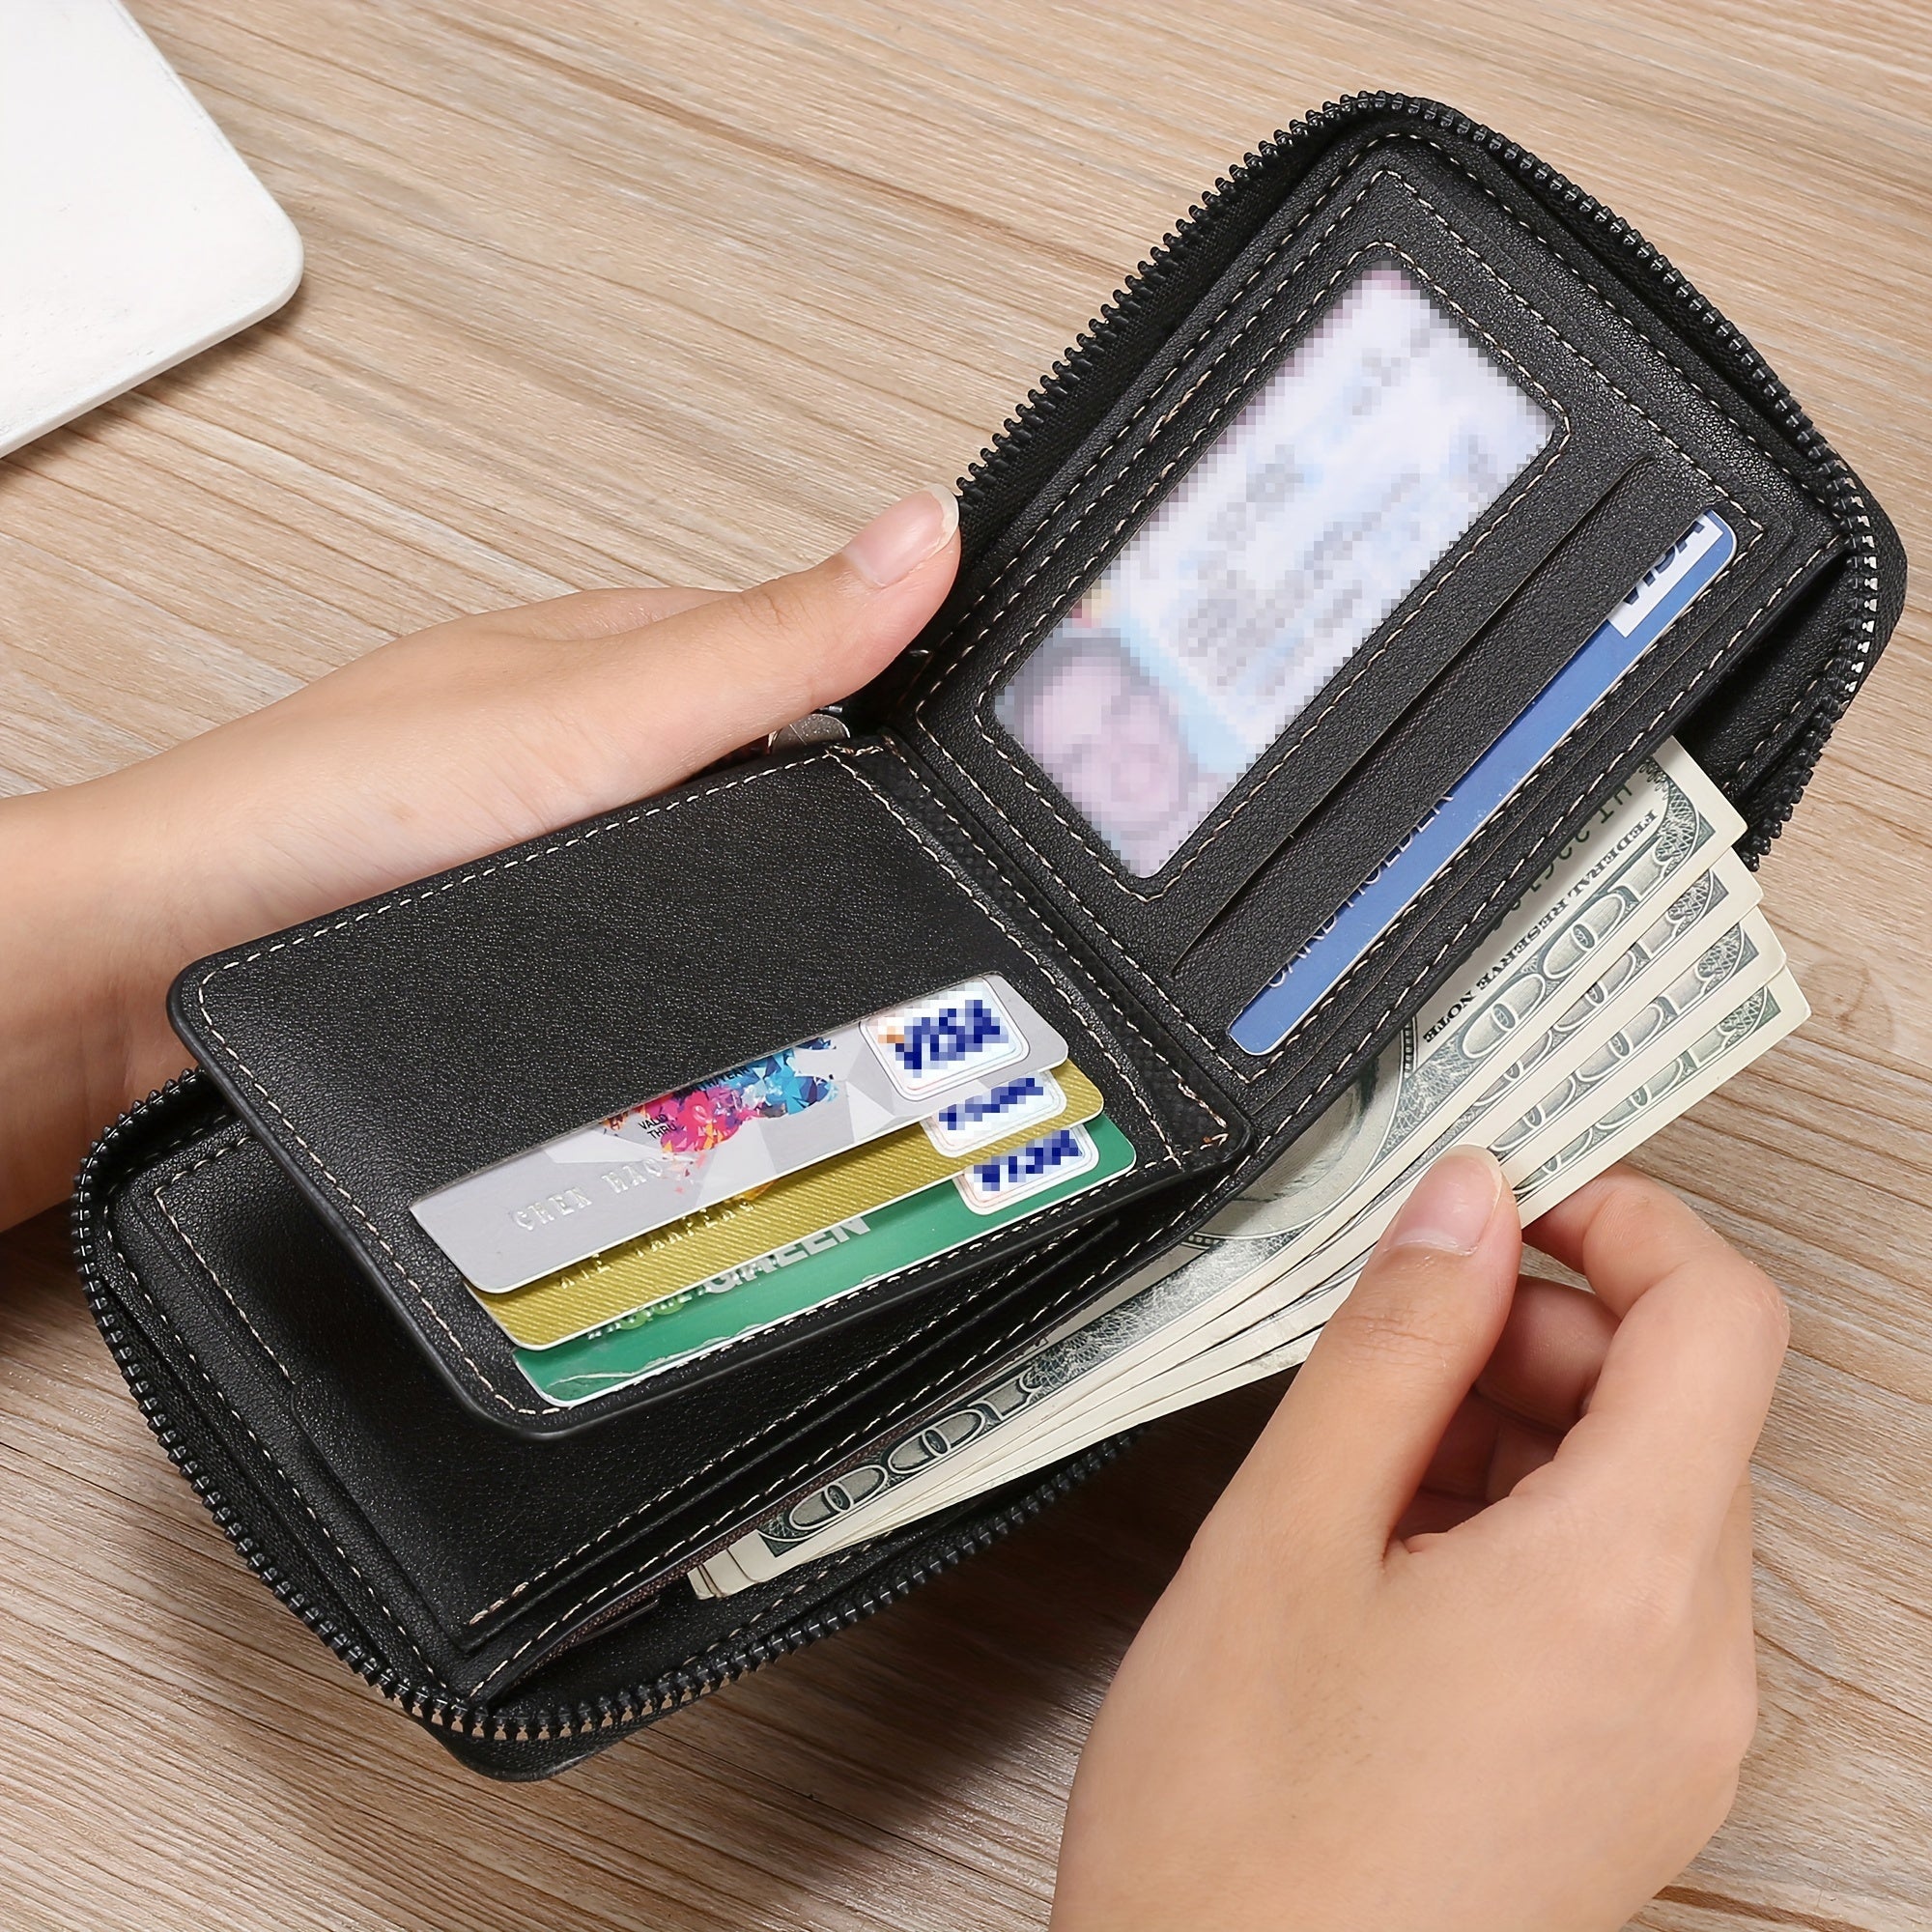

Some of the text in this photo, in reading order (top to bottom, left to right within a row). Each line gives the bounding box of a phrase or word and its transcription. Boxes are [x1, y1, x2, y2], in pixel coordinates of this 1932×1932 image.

[1568, 809, 1658, 903] FEDERAL
[1462, 838, 1673, 1060] 100
[1476, 896, 1569, 991] RESERVE
[1423, 988, 1475, 1044] NOTE
[638, 1113, 668, 1129] VALID
[647, 1122, 677, 1140] THRU
[787, 1374, 1037, 1530] 100
